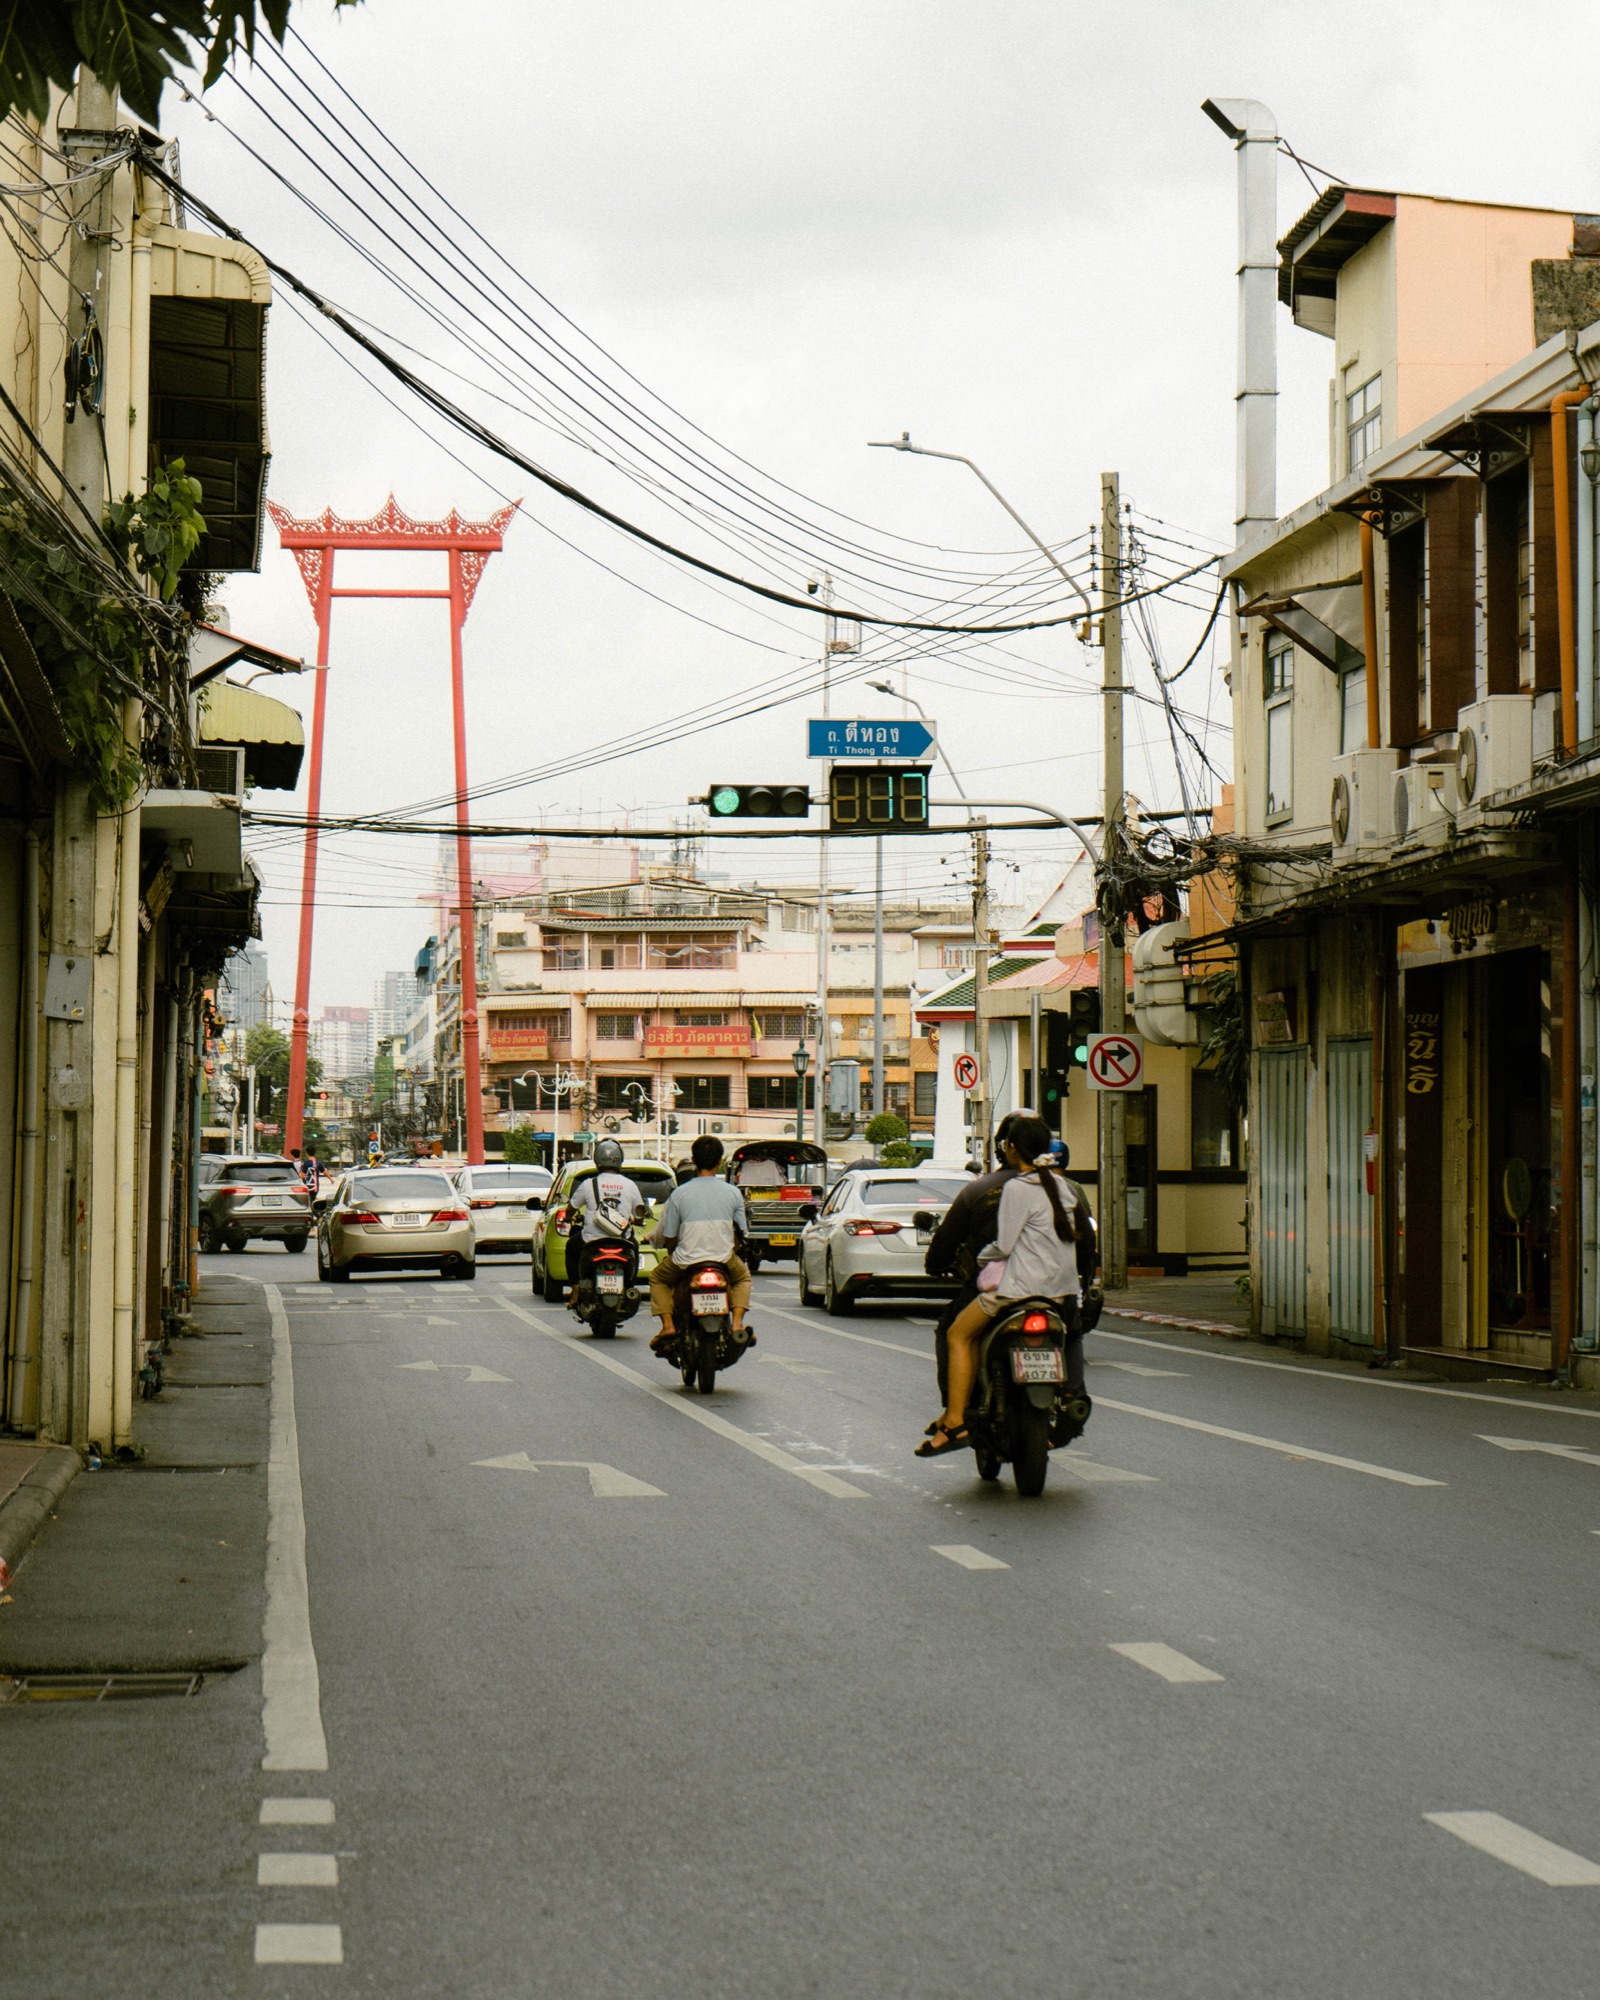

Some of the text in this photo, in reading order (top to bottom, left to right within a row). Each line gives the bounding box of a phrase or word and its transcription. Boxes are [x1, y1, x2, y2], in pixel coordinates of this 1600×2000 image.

[827, 721, 900, 743] ถ. ตีทอง
[828, 746, 899, 756] Ti Thong Rd.
